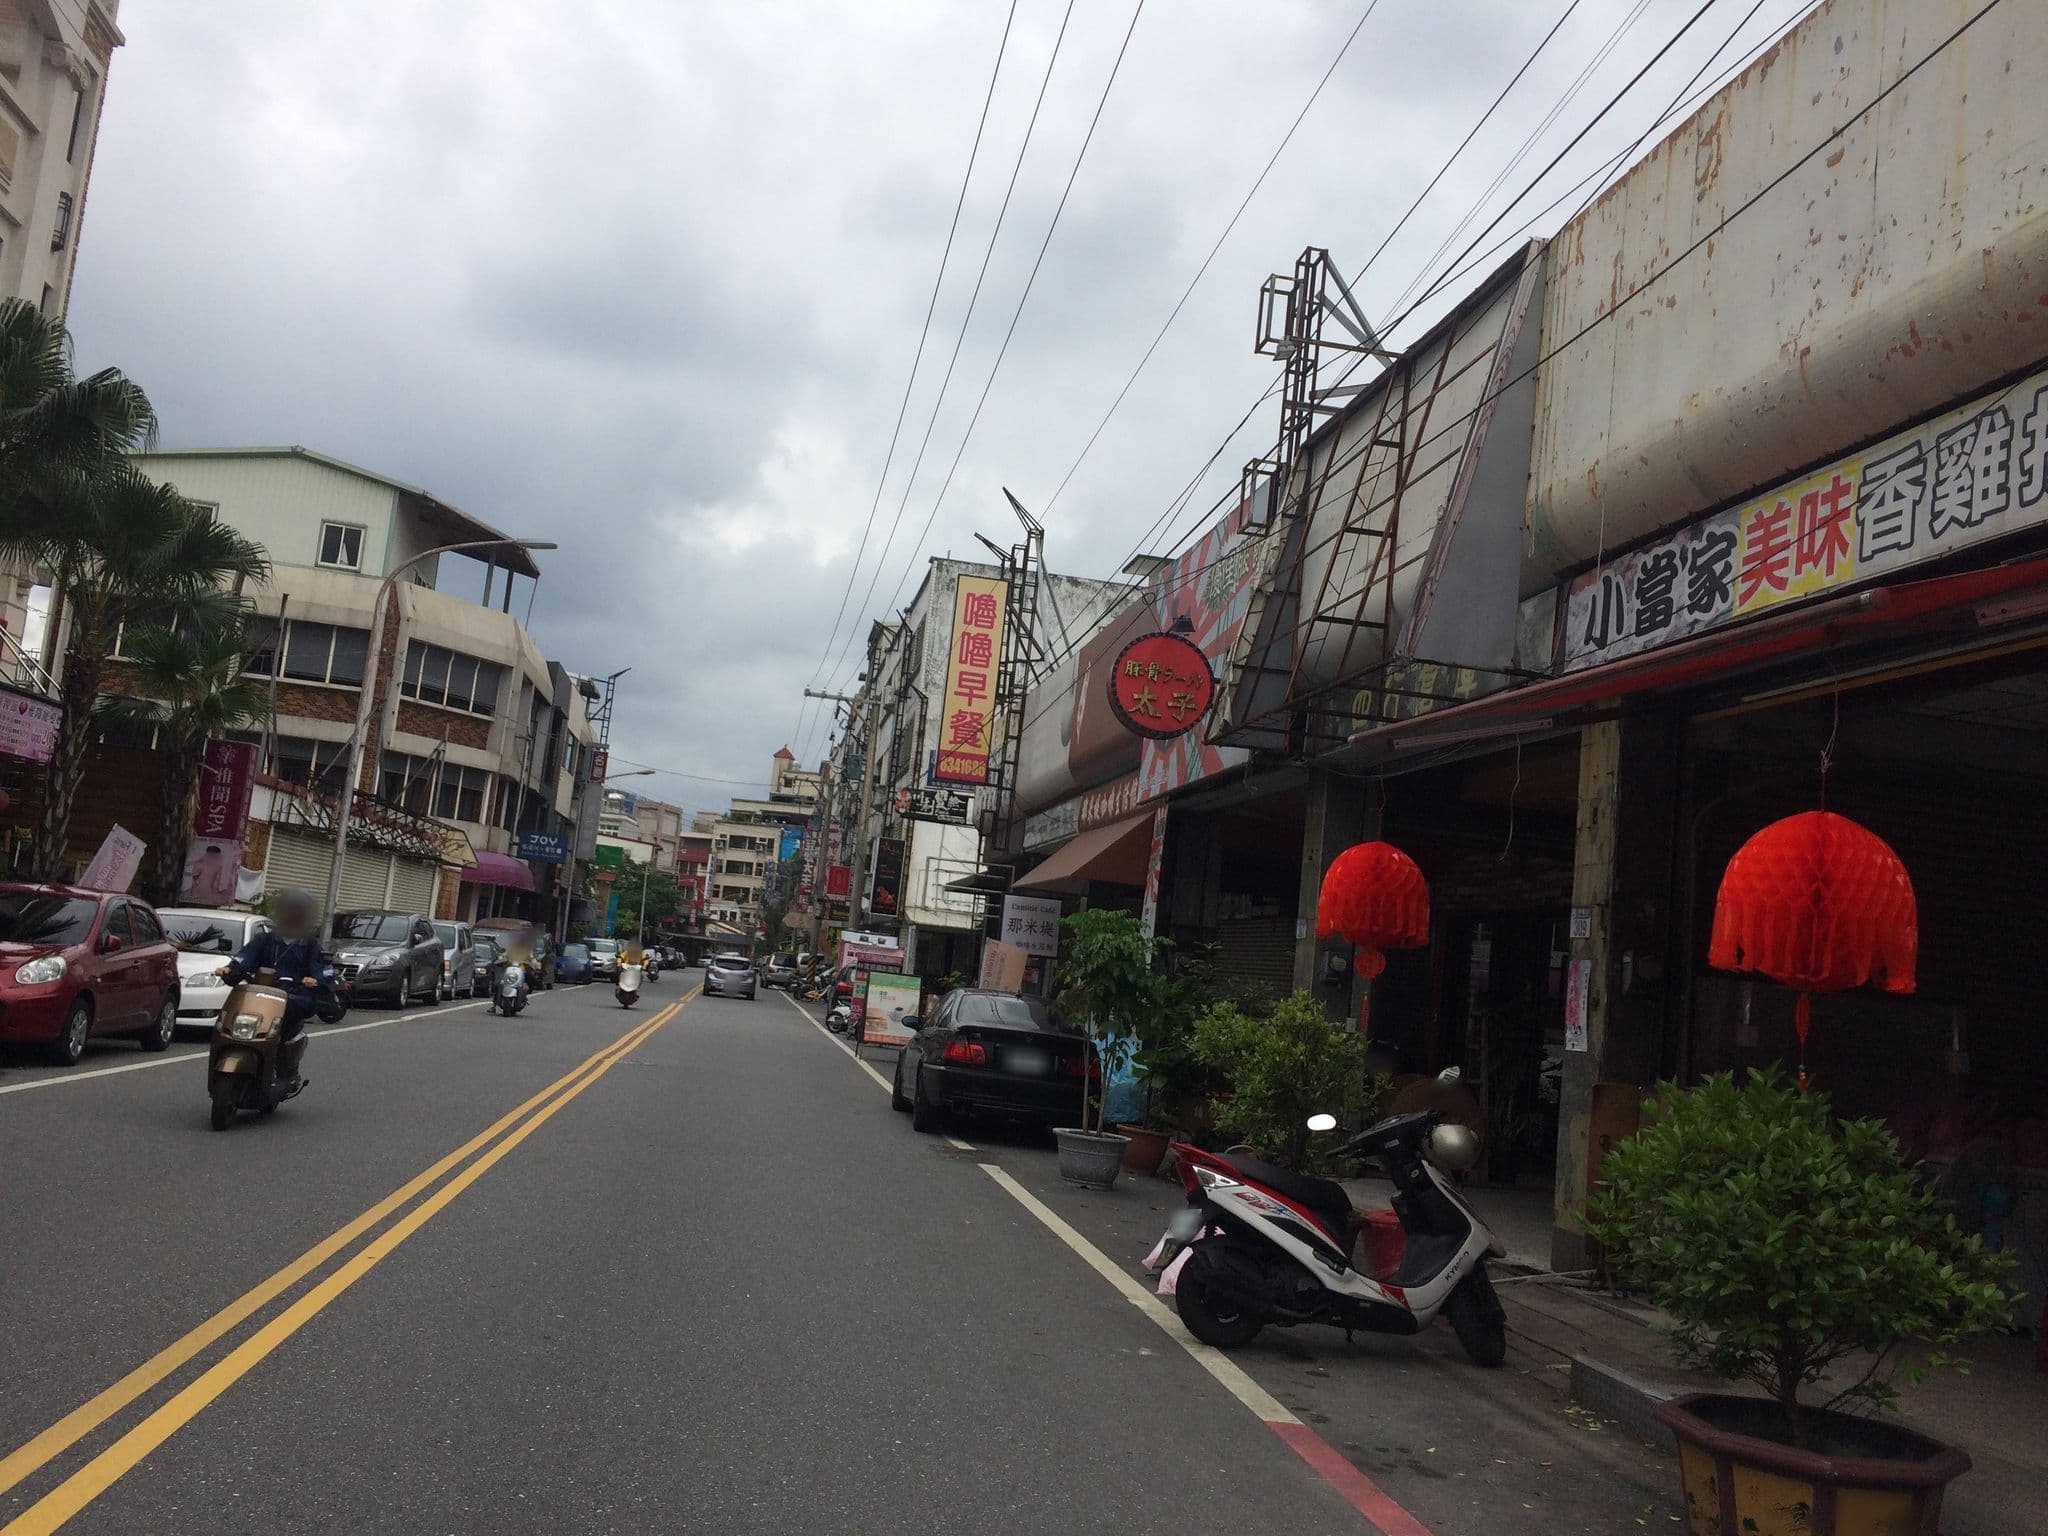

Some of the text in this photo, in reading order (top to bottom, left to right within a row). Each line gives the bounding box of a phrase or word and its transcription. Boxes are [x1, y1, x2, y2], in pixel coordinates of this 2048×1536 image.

[949, 592, 997, 748] 嚕嚕早餐
[1128, 685, 1197, 723] 太子
